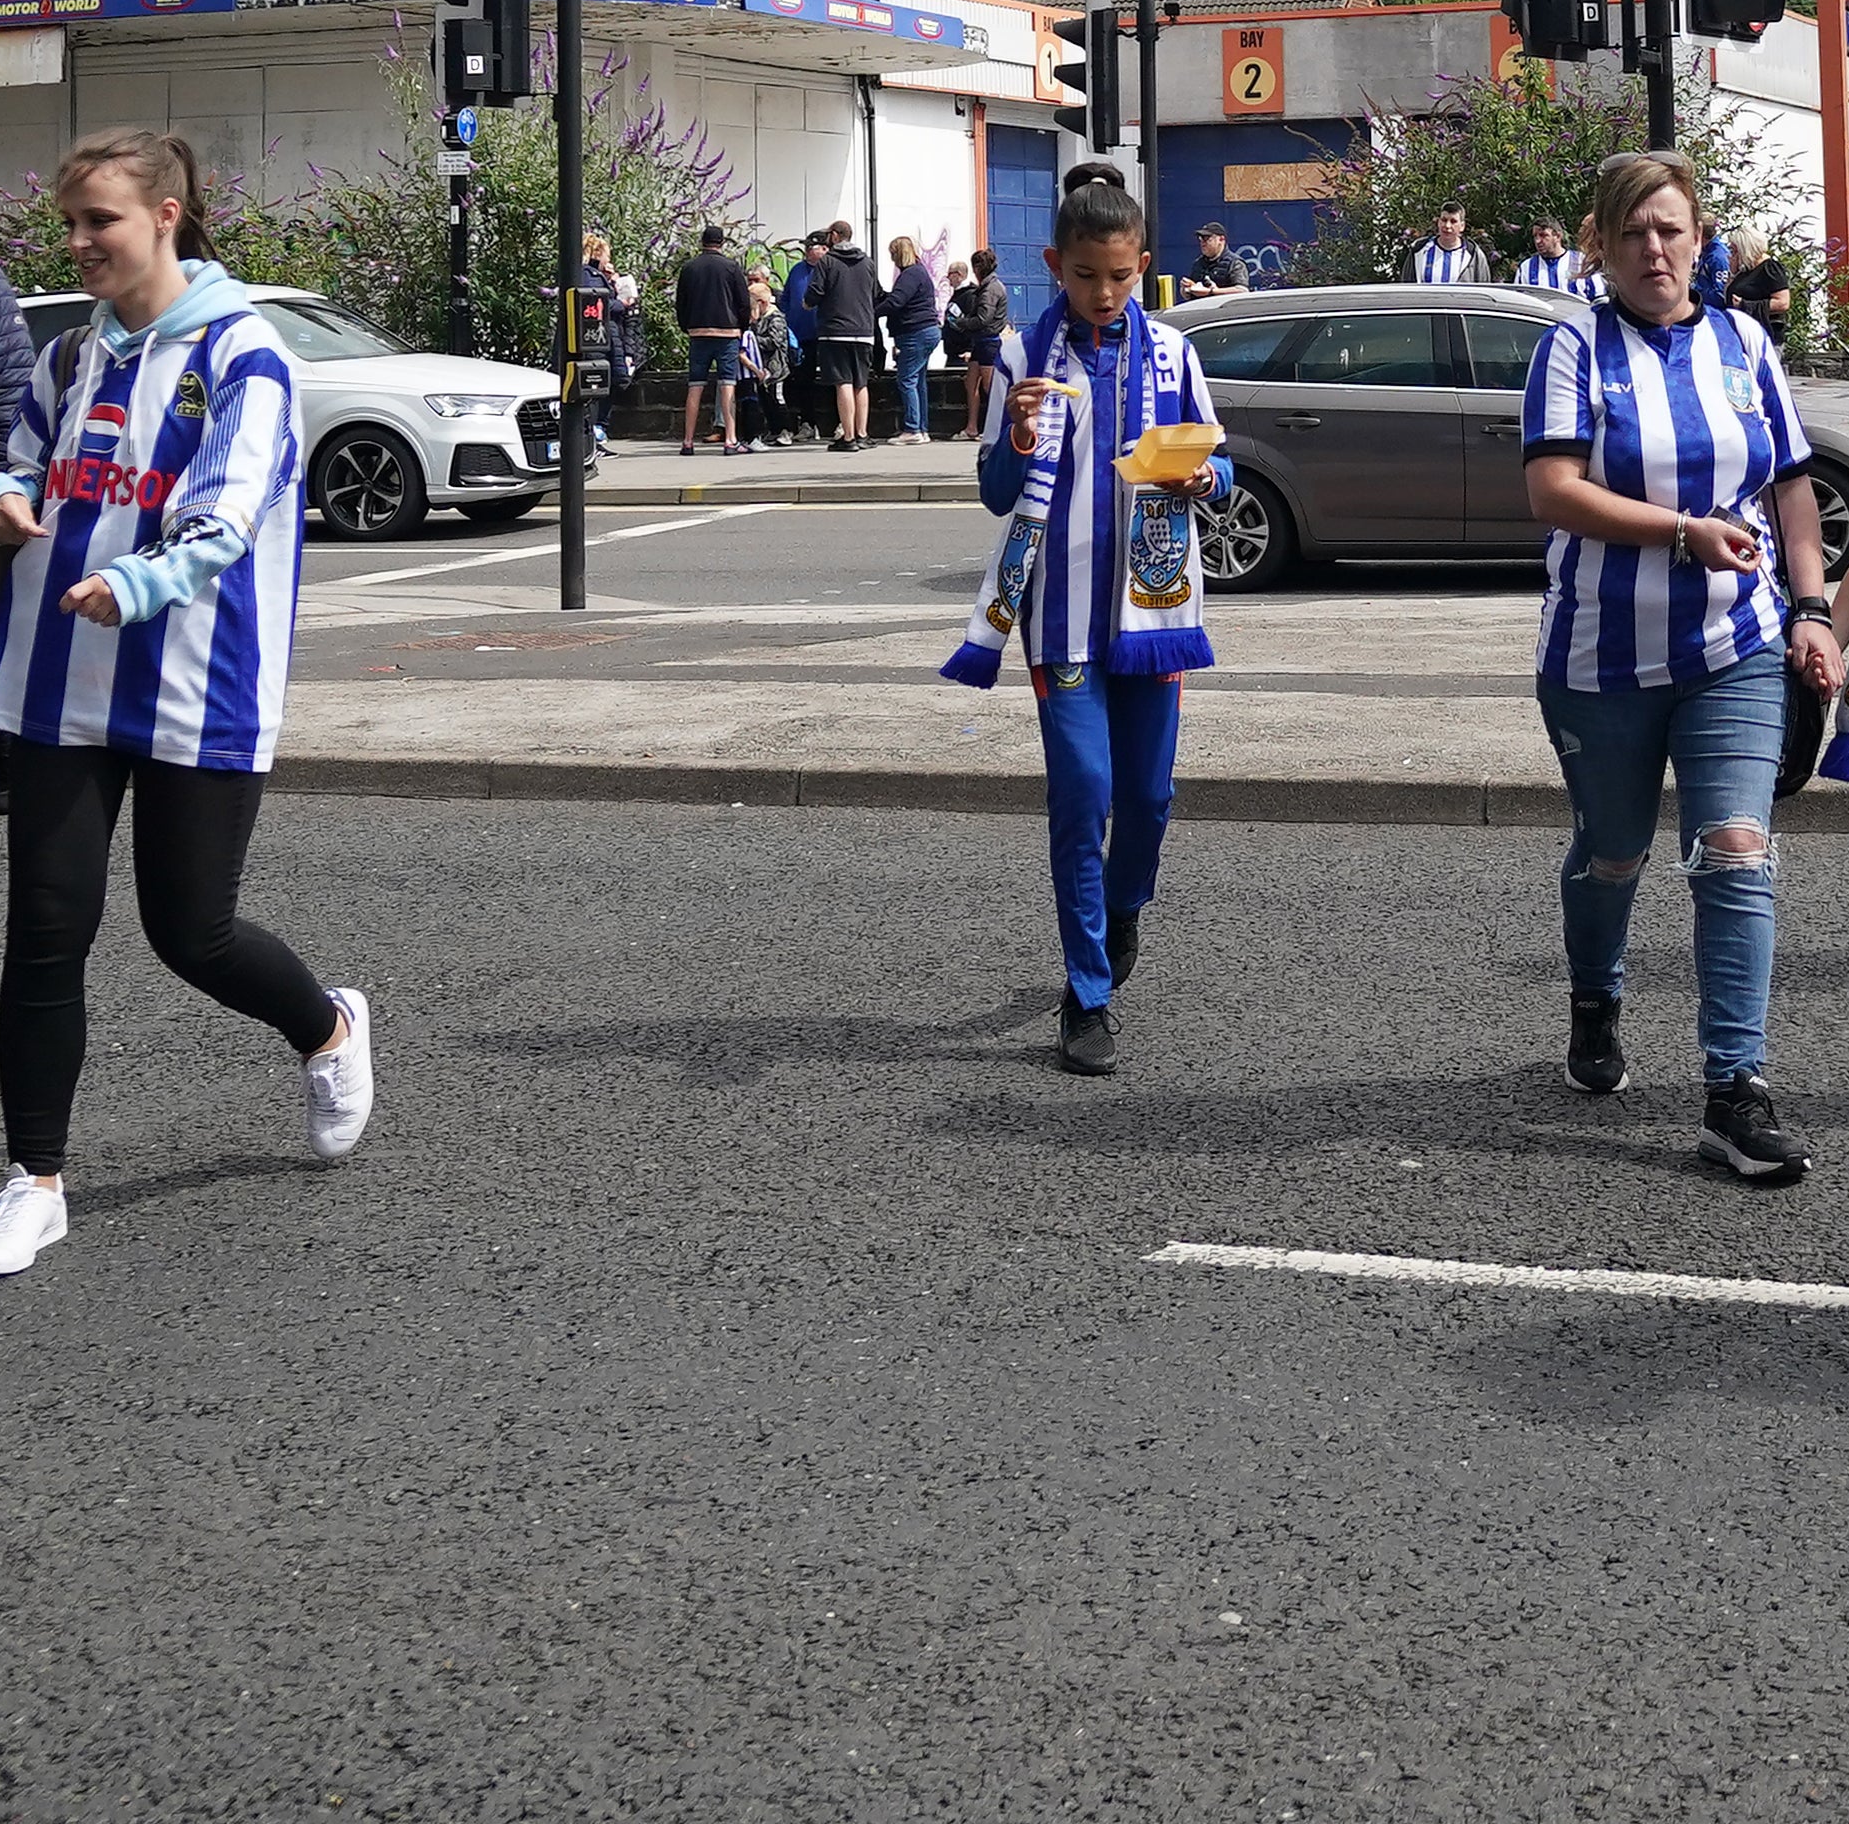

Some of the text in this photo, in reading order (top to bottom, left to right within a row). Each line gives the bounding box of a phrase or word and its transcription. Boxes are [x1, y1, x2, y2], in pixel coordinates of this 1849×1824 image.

[1587, 6, 1596, 20] D
[1240, 30, 1265, 48] BAY
[470, 58, 480, 71] D
[1047, 50, 1053, 84] 1
[1244, 63, 1262, 99] 2
